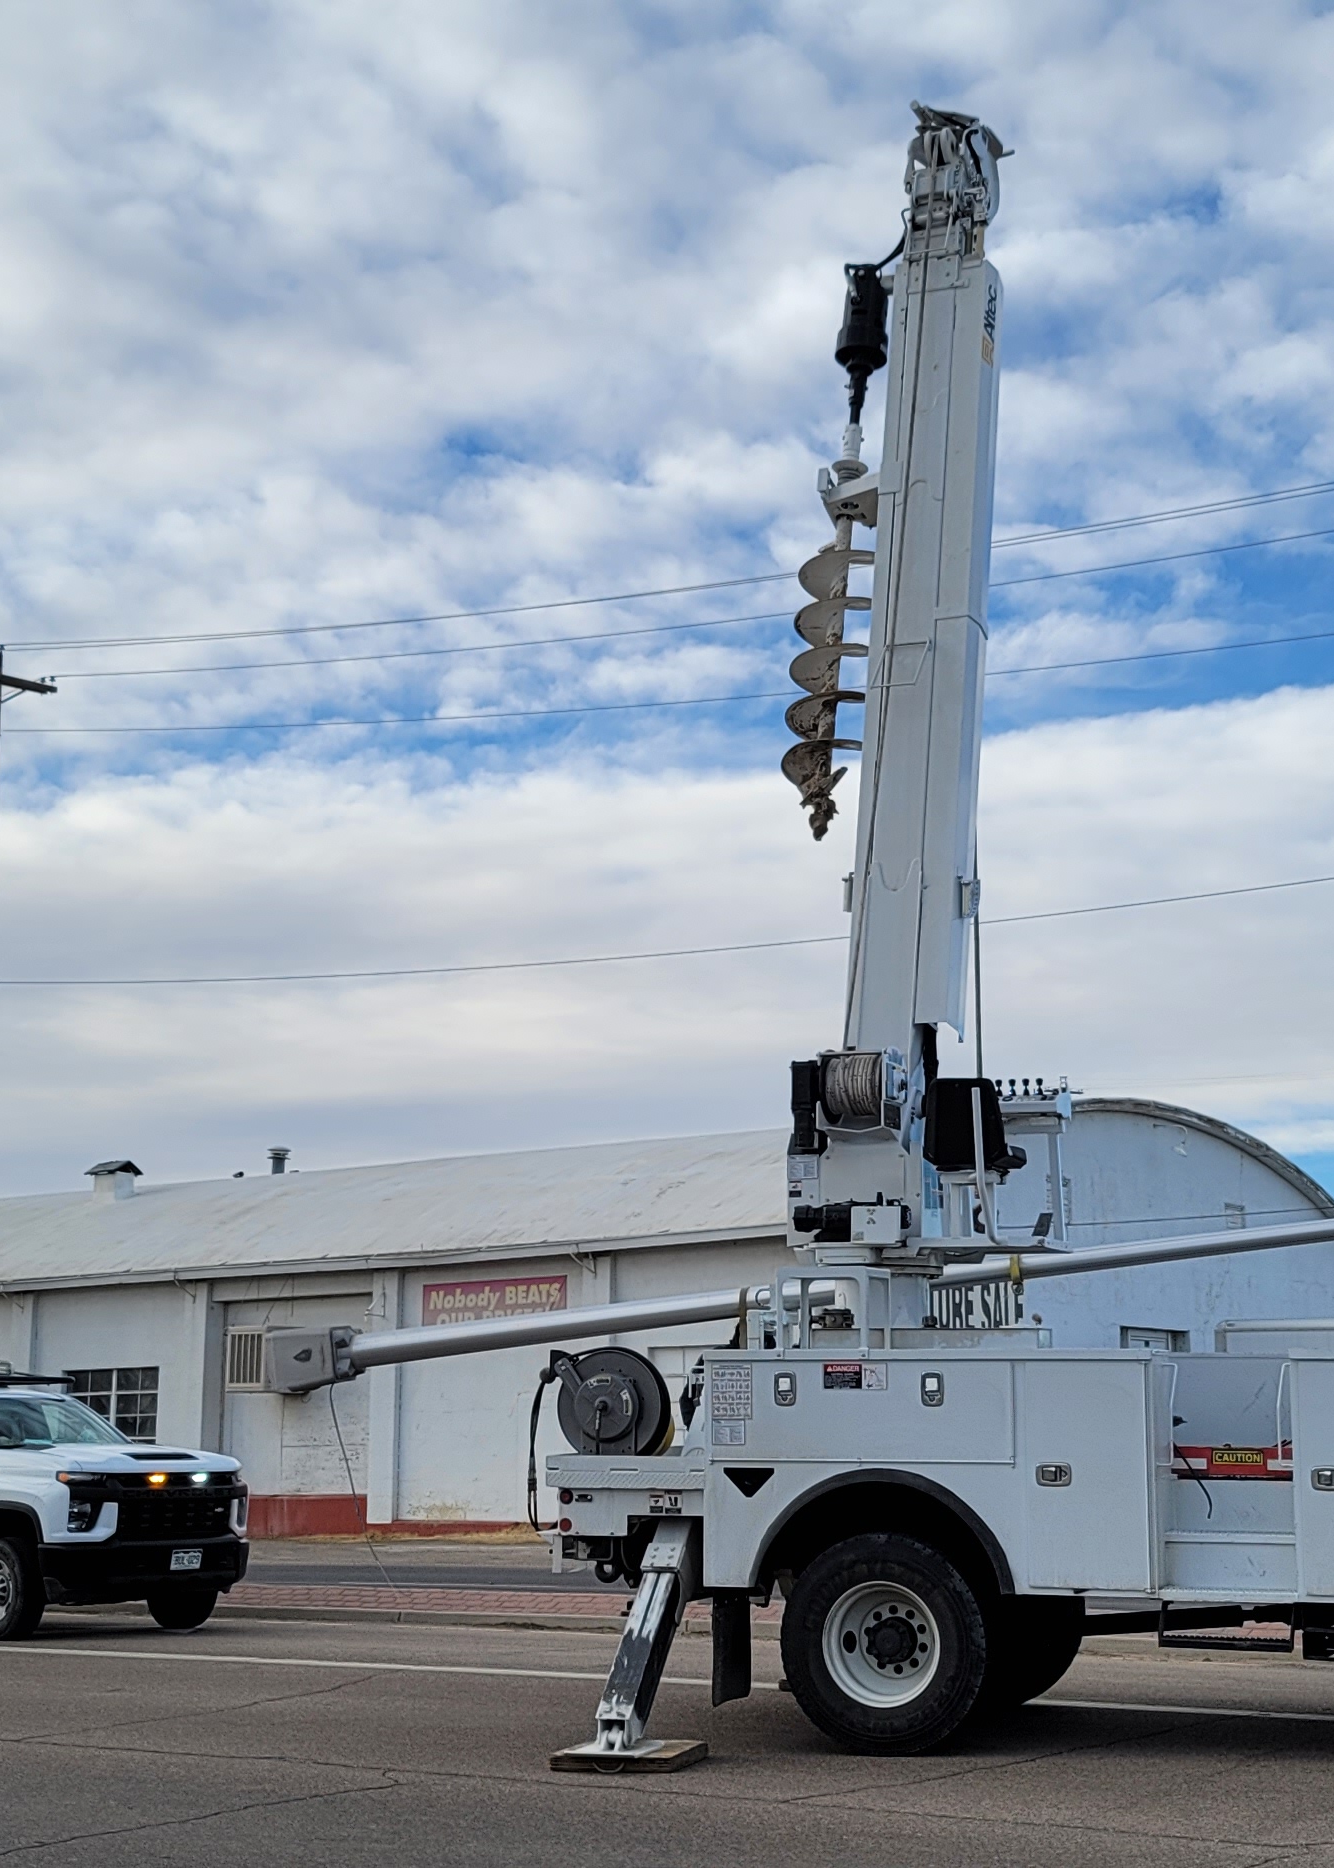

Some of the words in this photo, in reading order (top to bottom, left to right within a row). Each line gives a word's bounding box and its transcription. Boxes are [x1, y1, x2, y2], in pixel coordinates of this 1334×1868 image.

[983, 283, 998, 346] Altec
[429, 1286, 500, 1310] Nobody
[505, 1282, 561, 1305] BEATS
[1215, 1453, 1261, 1463] CAUTION
